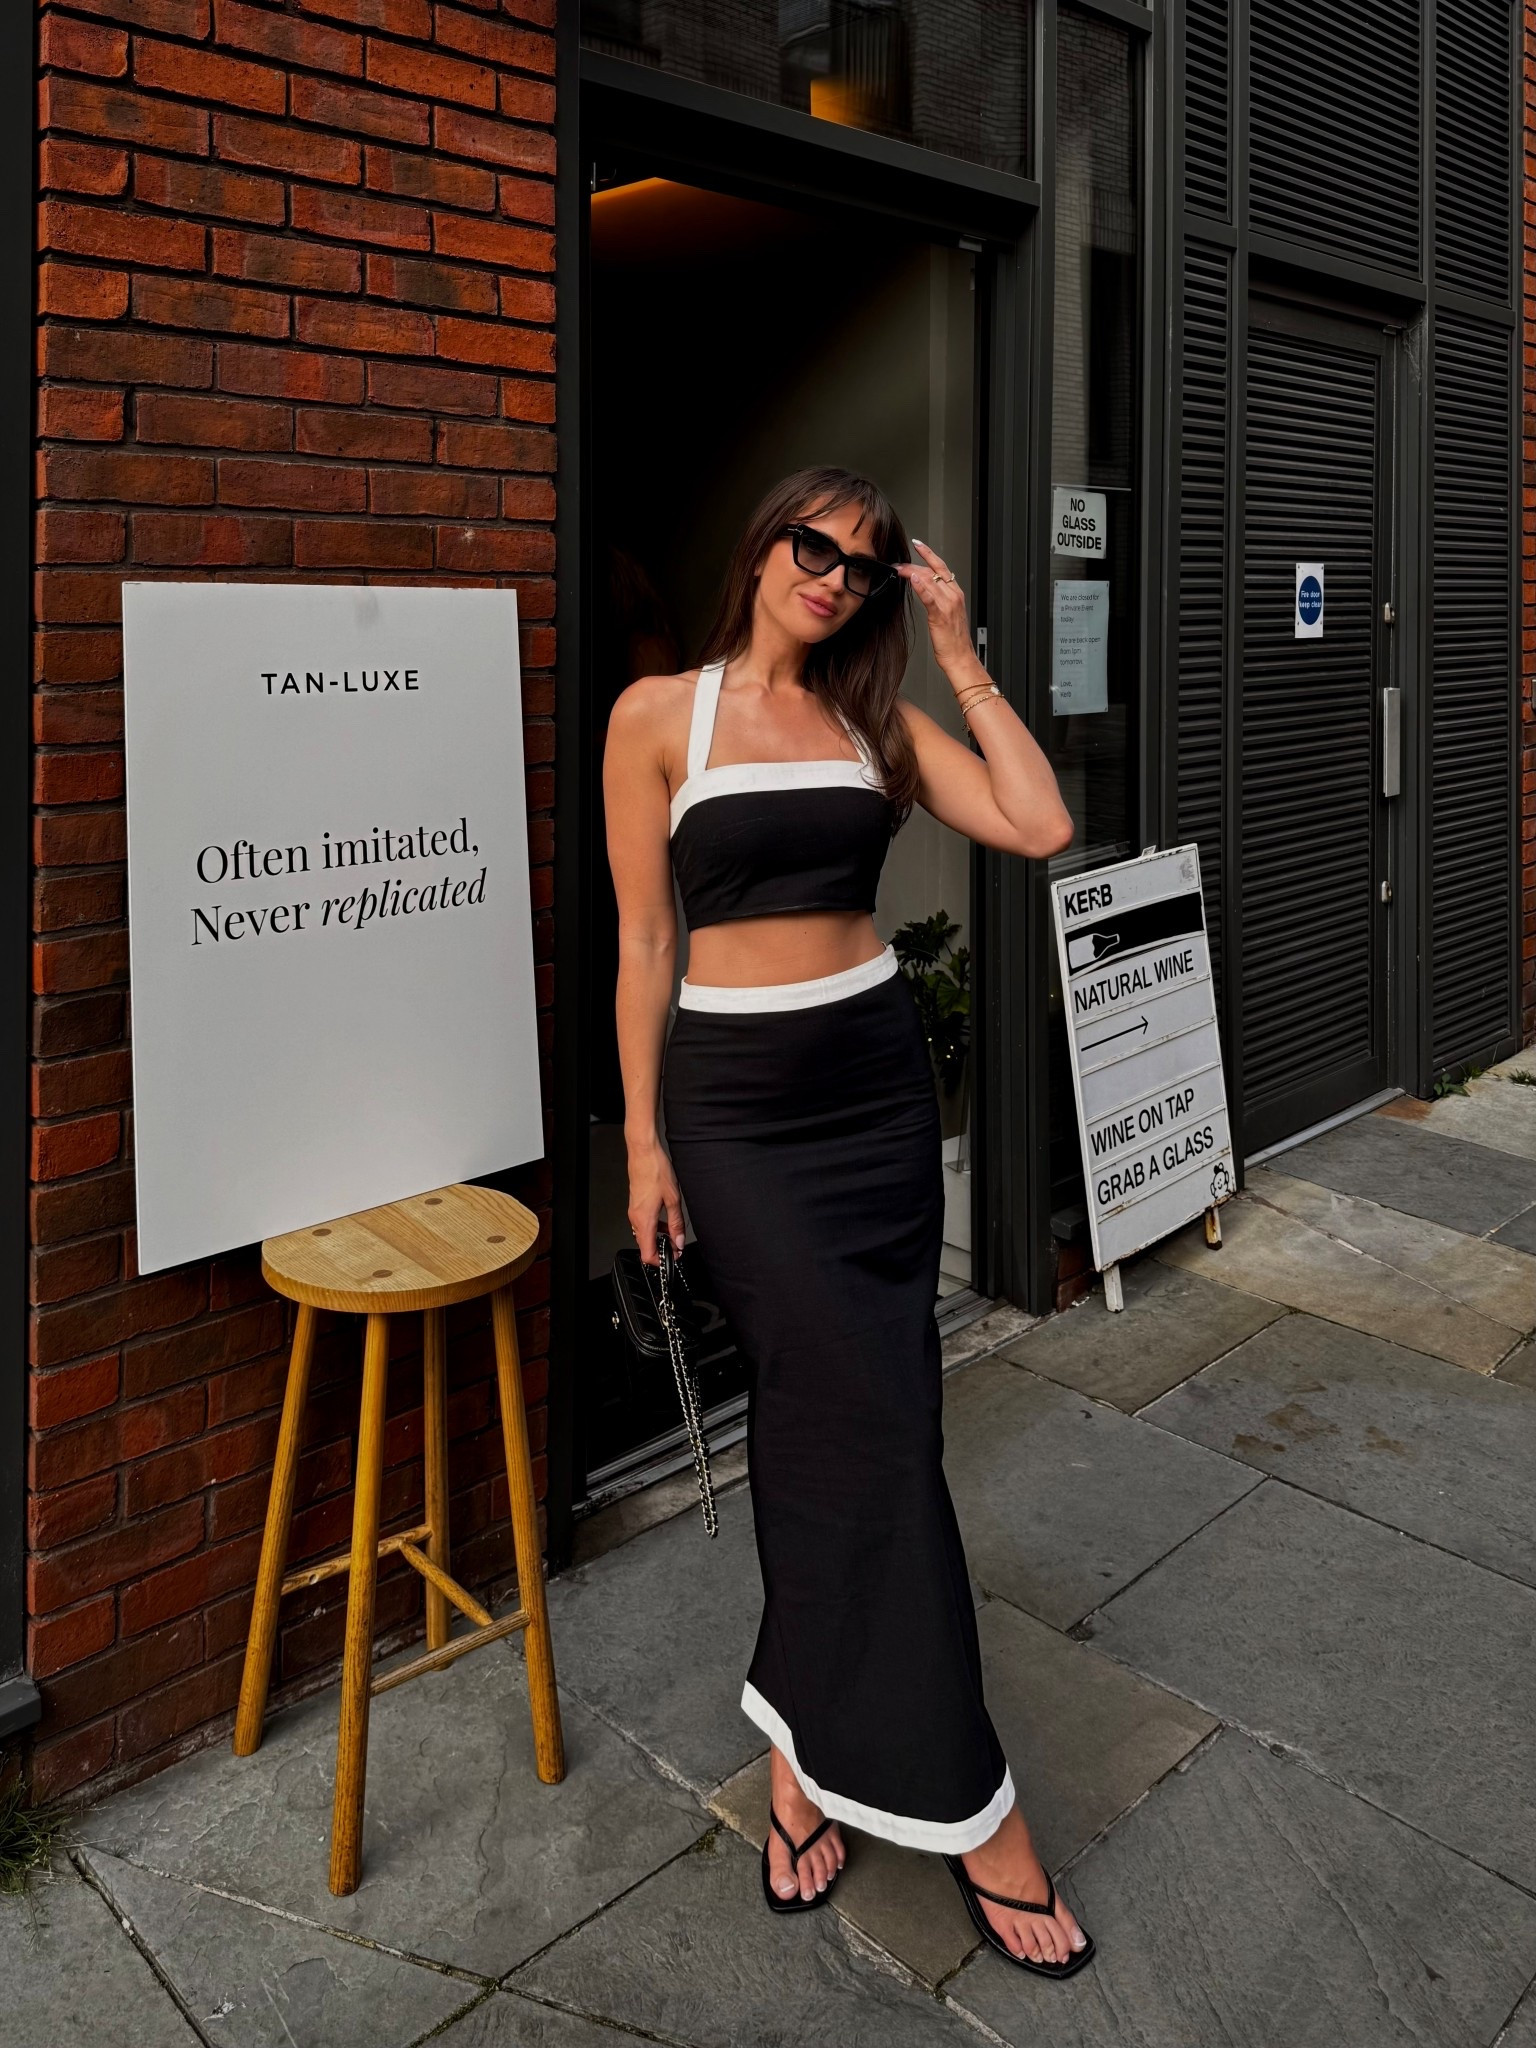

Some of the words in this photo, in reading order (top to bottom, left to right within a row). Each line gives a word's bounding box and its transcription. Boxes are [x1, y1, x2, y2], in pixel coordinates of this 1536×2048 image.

[1070, 497, 1085, 512] NO
[1062, 514, 1096, 531] GLASS
[1057, 532, 1102, 550] OUTSIDE
[1299, 600, 1310, 610] keep
[1311, 600, 1322, 608] clear
[1301, 590, 1310, 598] Fire
[1310, 590, 1320, 598] door
[1088, 637, 1101, 645] open
[261, 669, 420, 695] TAN-LUXE
[196, 839, 311, 884] Often
[321, 817, 479, 870] imitated,
[190, 900, 311, 946] Never
[320, 867, 488, 930] replicated
[1064, 883, 1113, 918] KERB
[1074, 966, 1153, 1014] NATURAL
[1154, 949, 1194, 983] WINE
[1090, 1115, 1136, 1156] WINE
[1138, 1102, 1164, 1133] ON
[1165, 1088, 1195, 1119] TAP
[1097, 1162, 1145, 1205] GRAB
[1149, 1155, 1161, 1180] A
[1163, 1126, 1214, 1171] GLASS
